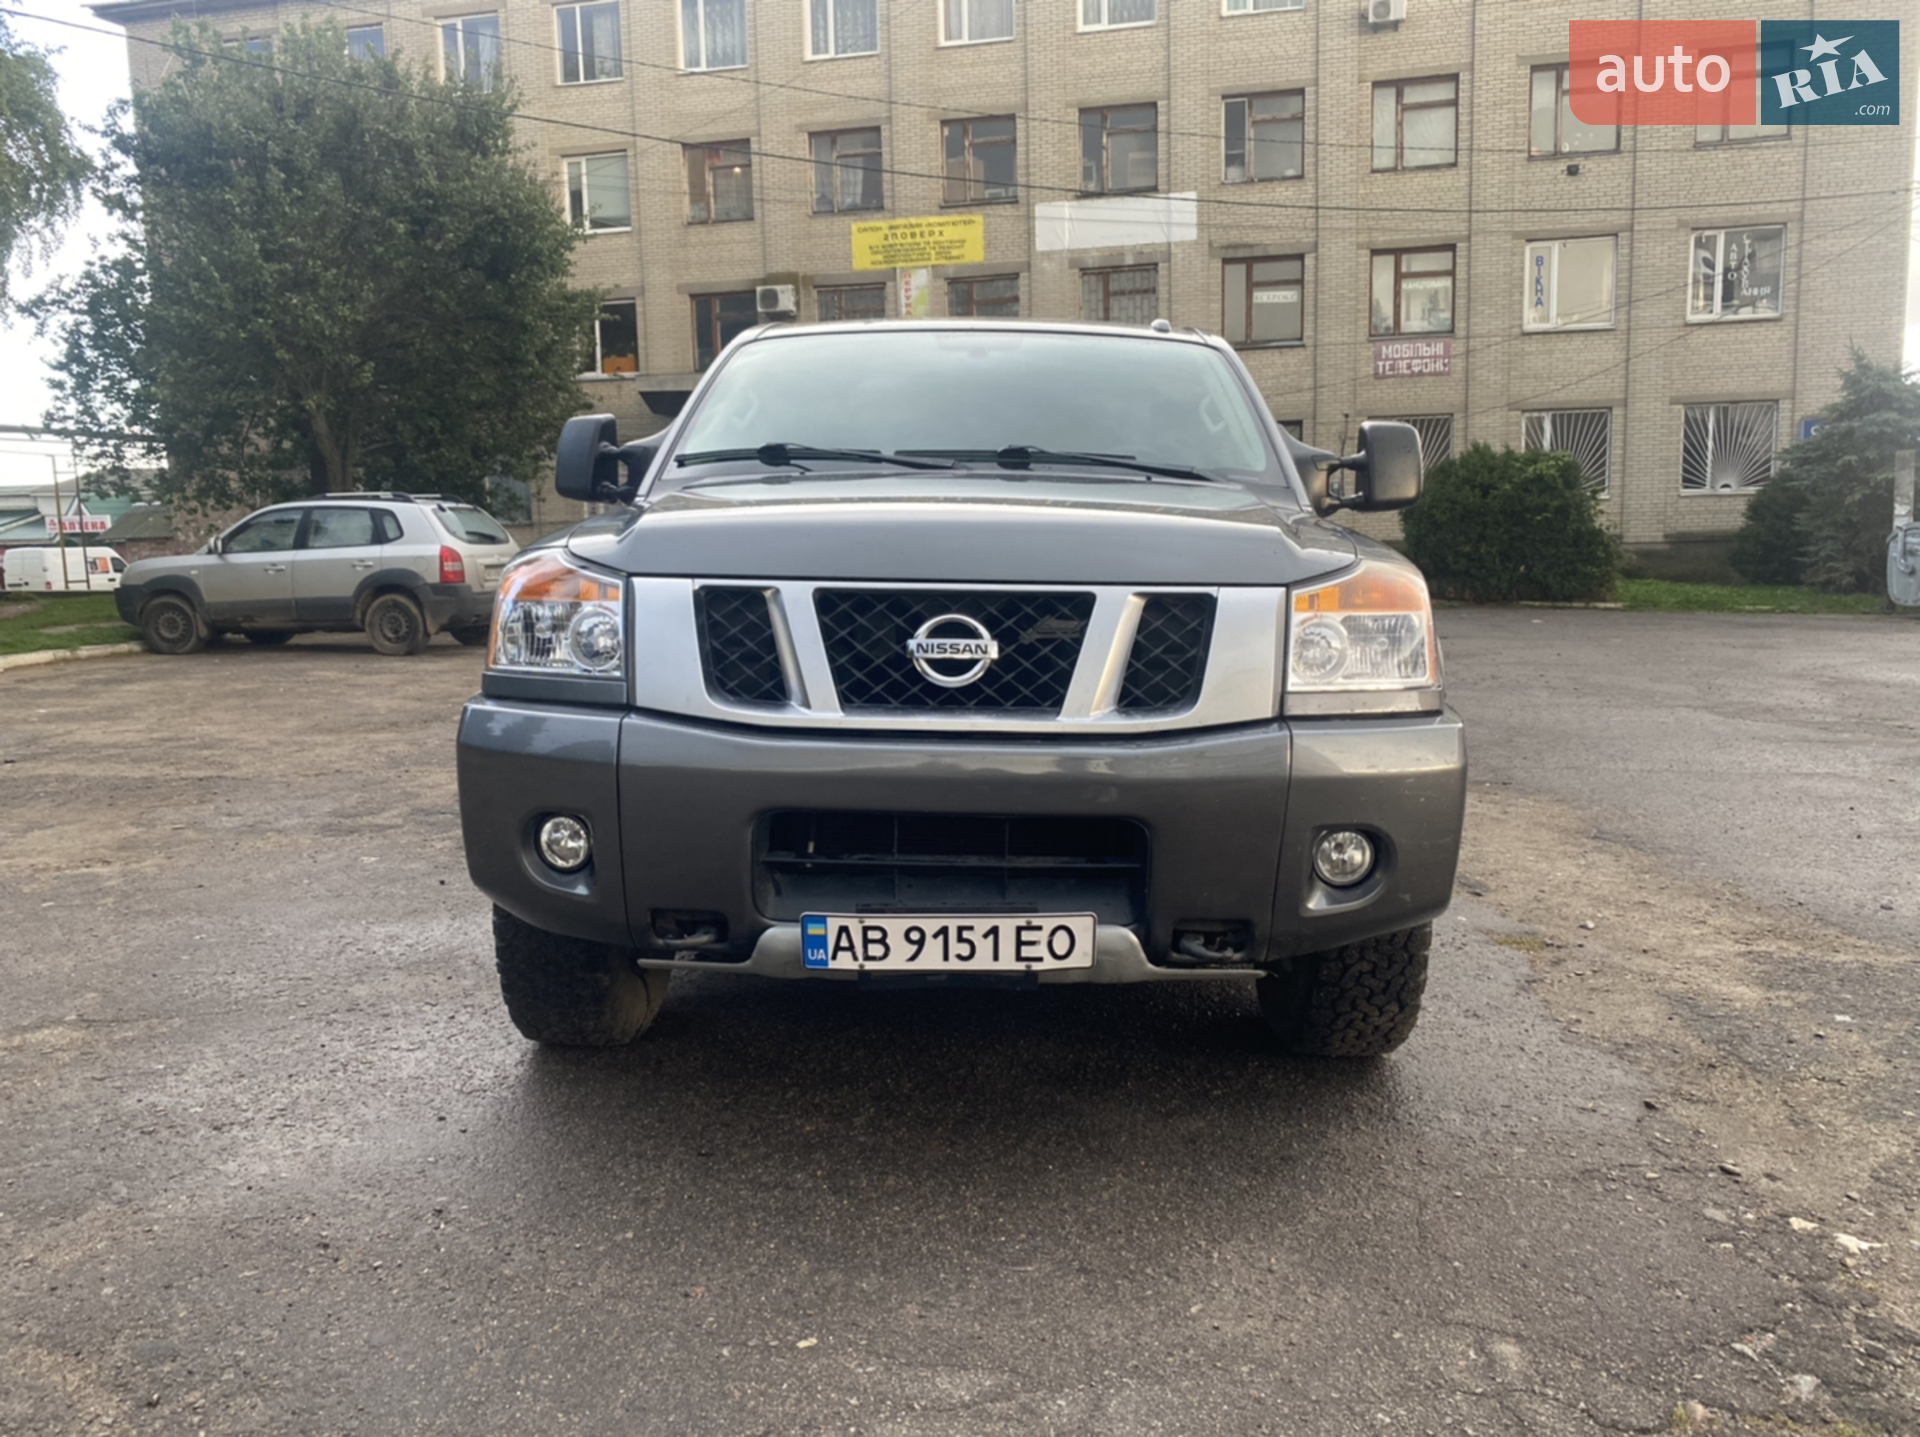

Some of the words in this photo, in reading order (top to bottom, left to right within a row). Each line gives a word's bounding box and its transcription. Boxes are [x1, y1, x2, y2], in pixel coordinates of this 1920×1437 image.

[1727, 243, 1738, 280] АВТО
[1535, 255, 1544, 307] ВІКНА
[1382, 342, 1444, 359] МОБІЛЬНІ
[916, 643, 988, 654] NISSAN
[808, 949, 827, 960] UA
[830, 925, 891, 962] AB
[903, 925, 1000, 962] 9151
[1015, 924, 1076, 962] EO
